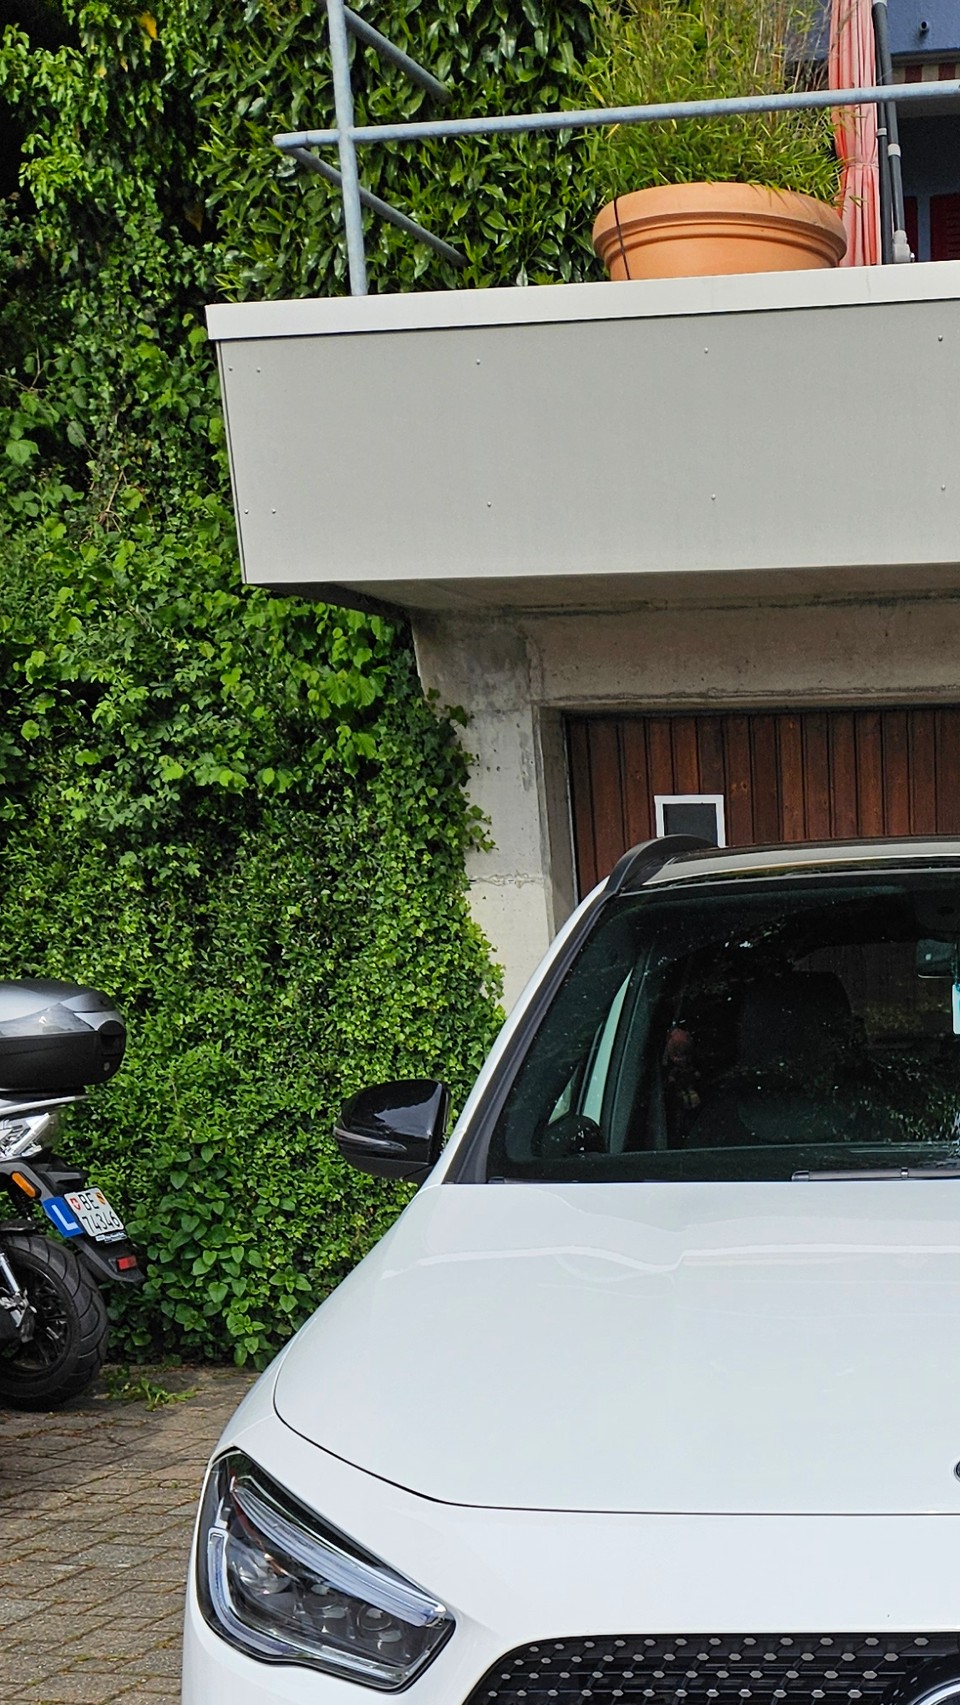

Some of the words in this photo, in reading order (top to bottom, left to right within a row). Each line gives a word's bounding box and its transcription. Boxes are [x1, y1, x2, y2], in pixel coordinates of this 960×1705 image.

[78, 1192, 100, 1211] BE
[51, 1204, 79, 1231] L
[82, 1210, 121, 1233] 74346
